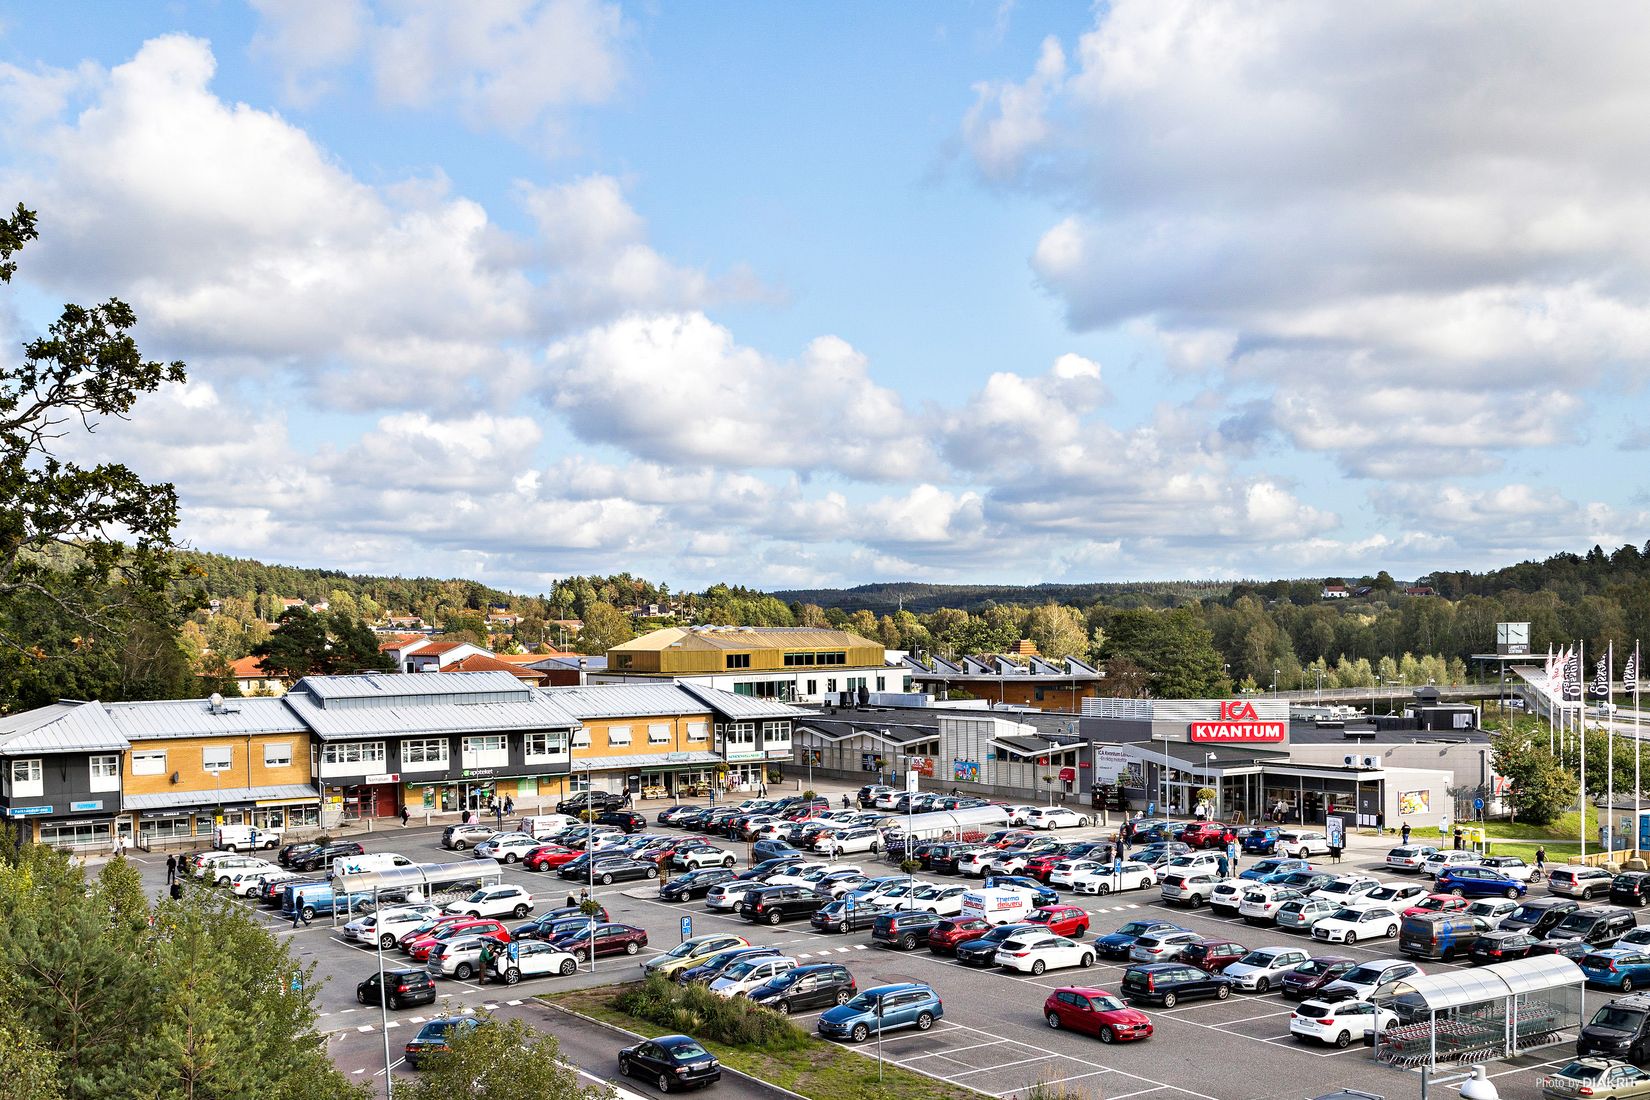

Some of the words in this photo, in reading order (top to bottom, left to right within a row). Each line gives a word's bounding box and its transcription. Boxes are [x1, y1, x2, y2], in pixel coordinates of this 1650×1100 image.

[1221, 701, 1259, 720] ICA
[1196, 725, 1280, 737] KVANTUM
[997, 901, 1023, 909] delivery
